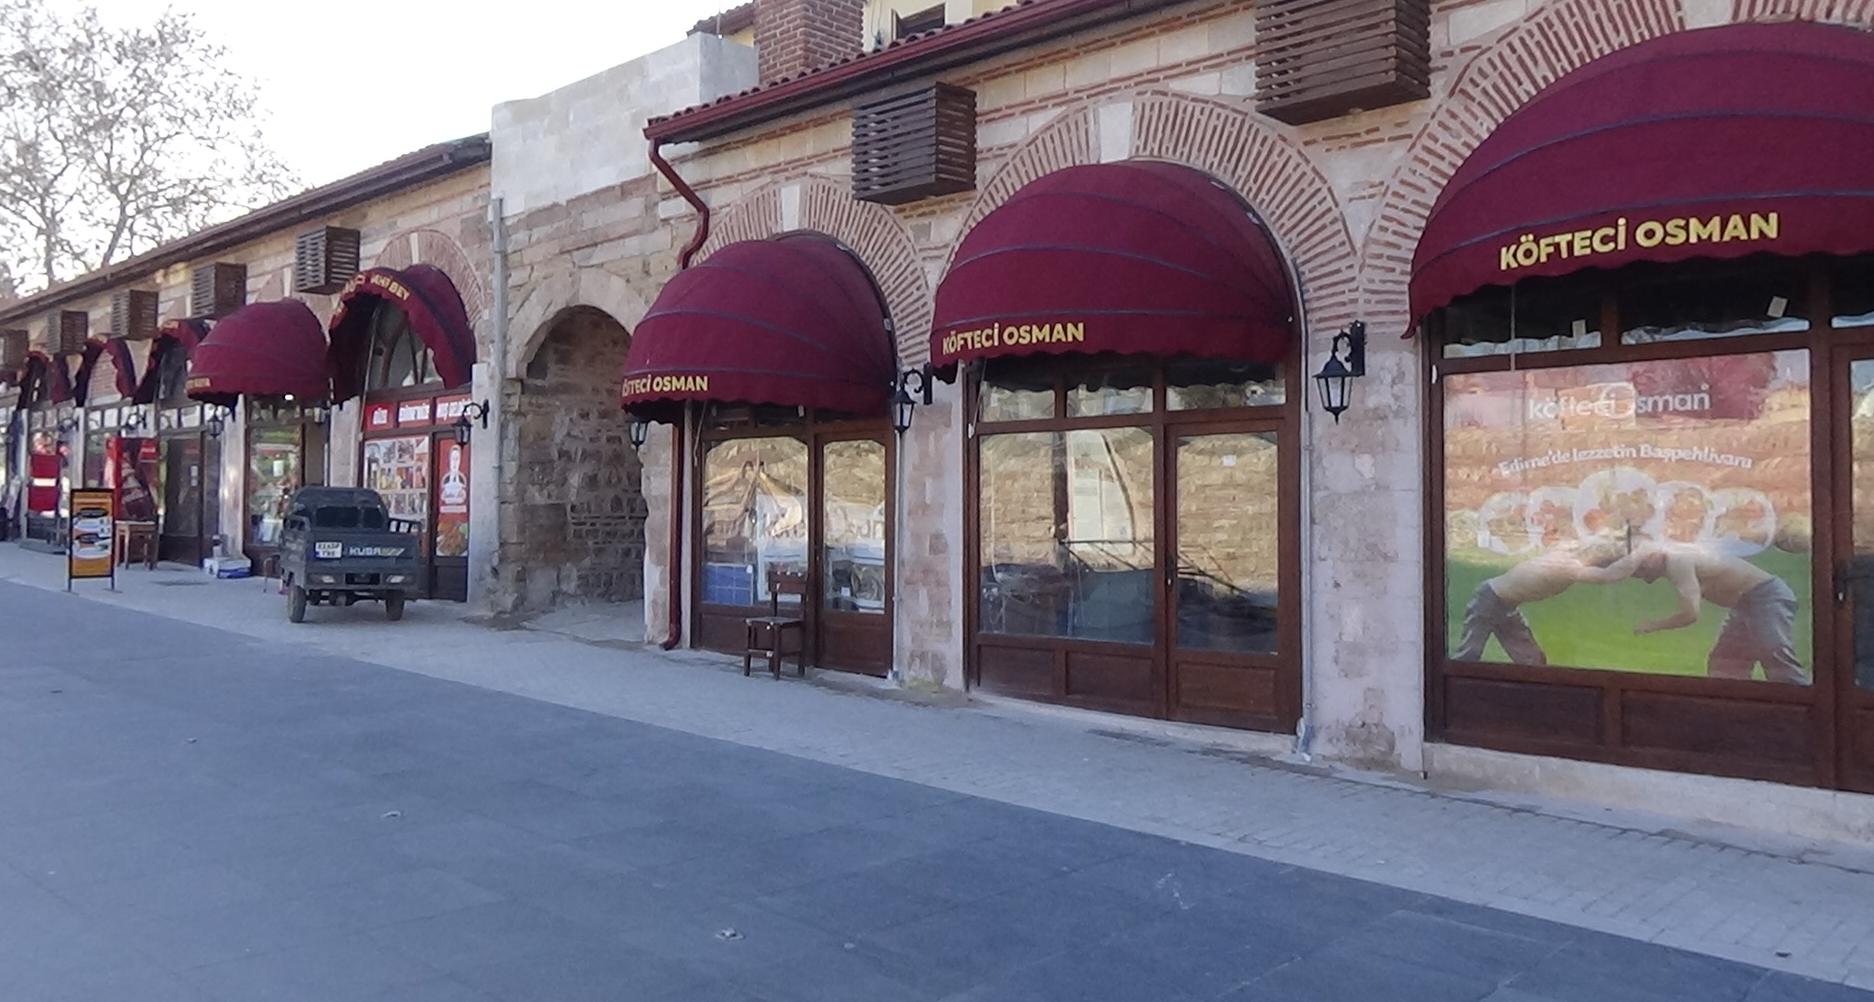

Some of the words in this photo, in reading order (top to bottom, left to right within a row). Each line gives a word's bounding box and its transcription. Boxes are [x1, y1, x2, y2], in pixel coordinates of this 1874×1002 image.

[1500, 217, 1626, 270] KÖFTECİ
[1635, 212, 1778, 248] OSMAN
[942, 322, 999, 355] KÖFTECİ
[1002, 322, 1084, 346] OSMAN
[652, 375, 708, 392] OSMAN
[1573, 446, 1637, 462] lezzetin
